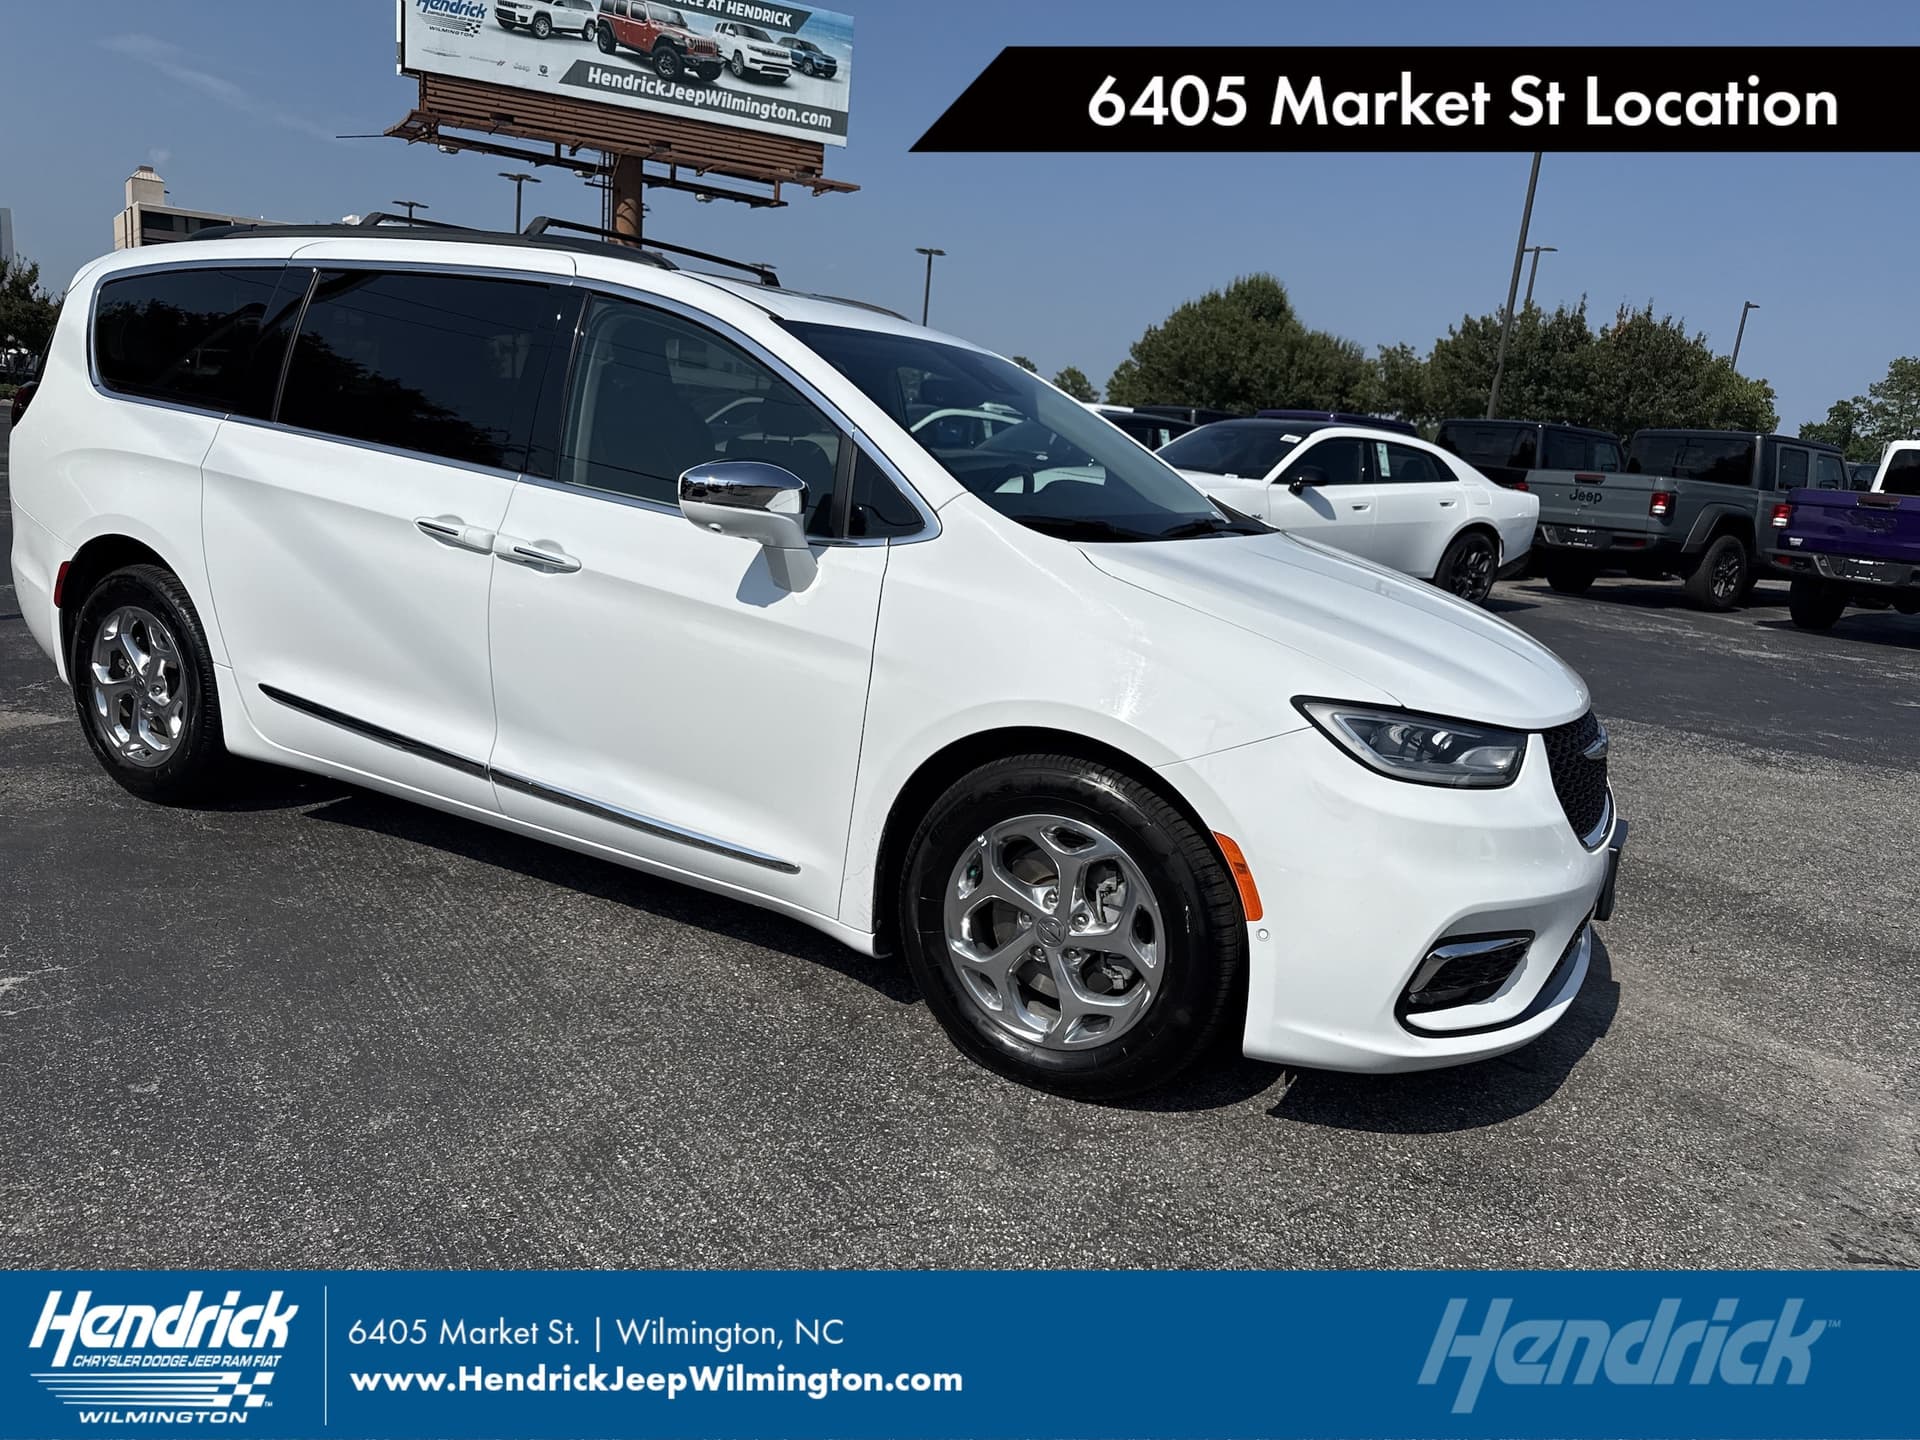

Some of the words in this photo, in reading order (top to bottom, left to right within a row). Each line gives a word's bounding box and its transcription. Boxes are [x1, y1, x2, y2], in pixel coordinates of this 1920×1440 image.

[706, 0, 725, 11] AT
[726, 1, 793, 27] HENDRICK
[429, 26, 475, 38] WILMINGTON
[588, 66, 832, 128] HendrickJeepWilmington.com
[1569, 489, 1602, 505] Jeep
